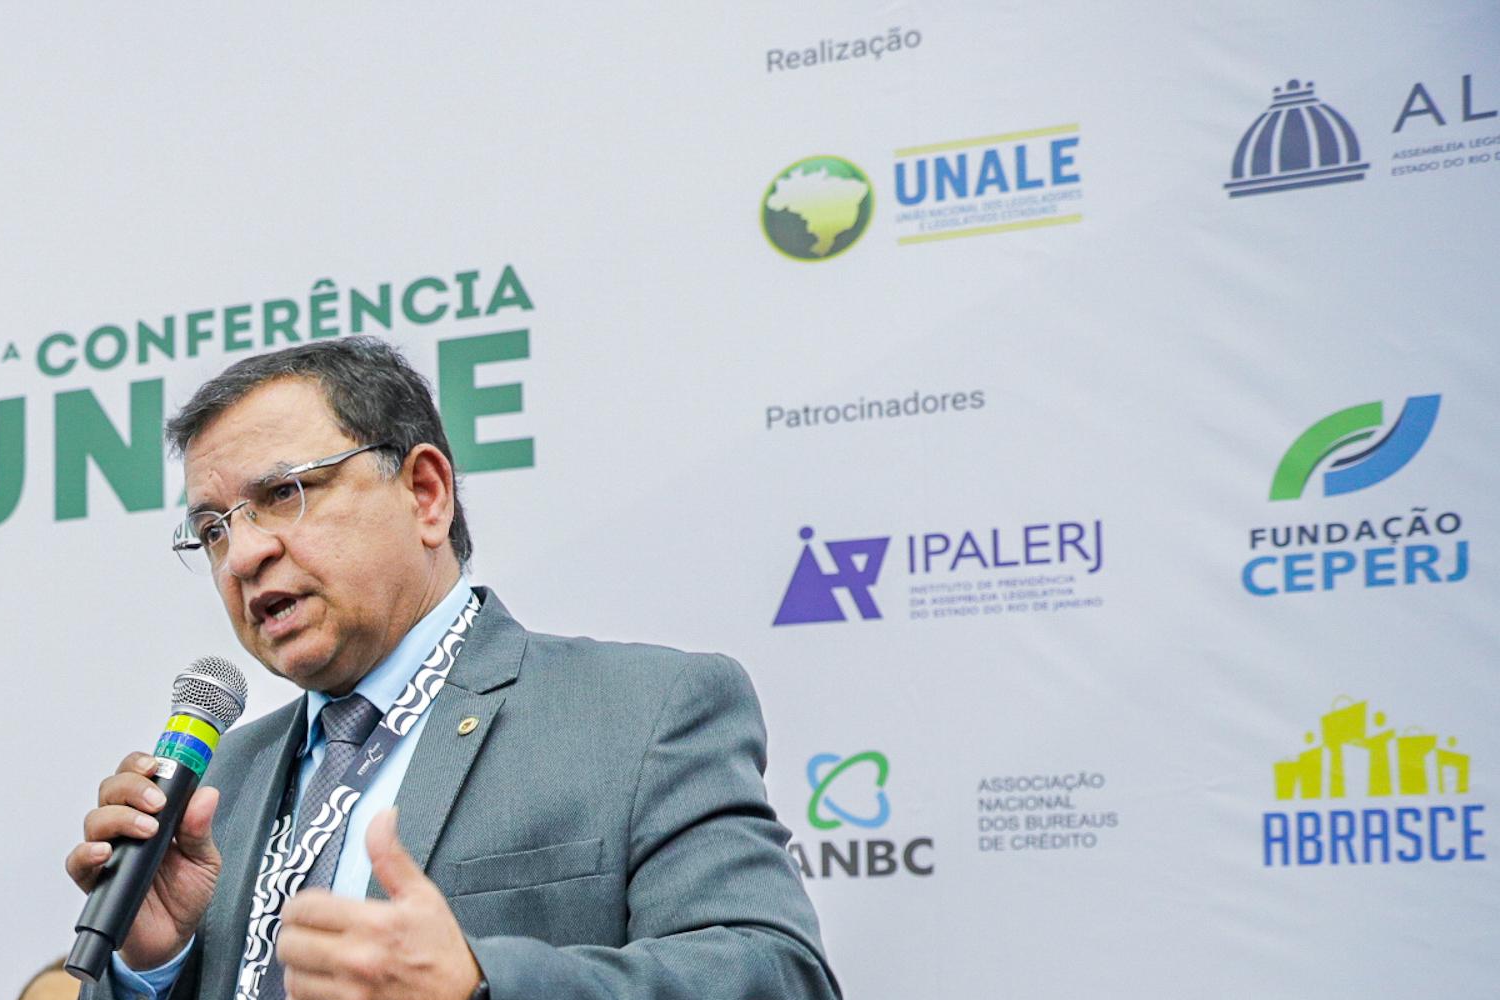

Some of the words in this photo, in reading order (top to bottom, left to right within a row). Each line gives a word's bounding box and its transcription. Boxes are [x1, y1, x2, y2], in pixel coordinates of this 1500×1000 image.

[766, 26, 922, 73] Realização
[1393, 142, 1464, 159] ASSEMBLEIA
[894, 137, 1081, 207] UNALE
[1391, 161, 1440, 176] ESTADO
[1443, 158, 1464, 169] DO
[1468, 153, 1491, 164] RIO
[35, 263, 535, 378] CONFERÊNCIA
[766, 389, 986, 430] Patrocinadores
[1250, 506, 1462, 549] FUNDAÇÃO
[908, 519, 1104, 574] IPALERJ
[1241, 540, 1470, 597] CEPERJ
[910, 582, 973, 595] INSTITUTO
[977, 580, 992, 591] DE
[1002, 587, 1074, 601] LEGISLATIVA
[933, 606, 979, 618] ESTADO
[983, 604, 1003, 616] DO
[1008, 603, 1029, 614] RIO
[1033, 600, 1048, 611] DE
[978, 771, 1106, 794] ASSOCIAÇÃO
[978, 796, 1076, 812] NACIONAL
[978, 815, 1020, 833] DOS
[1025, 811, 1119, 831] BUREAUS
[979, 835, 1005, 852] DE
[1010, 831, 1098, 851] CRÉDITO
[1263, 804, 1486, 867] ABRASCE
